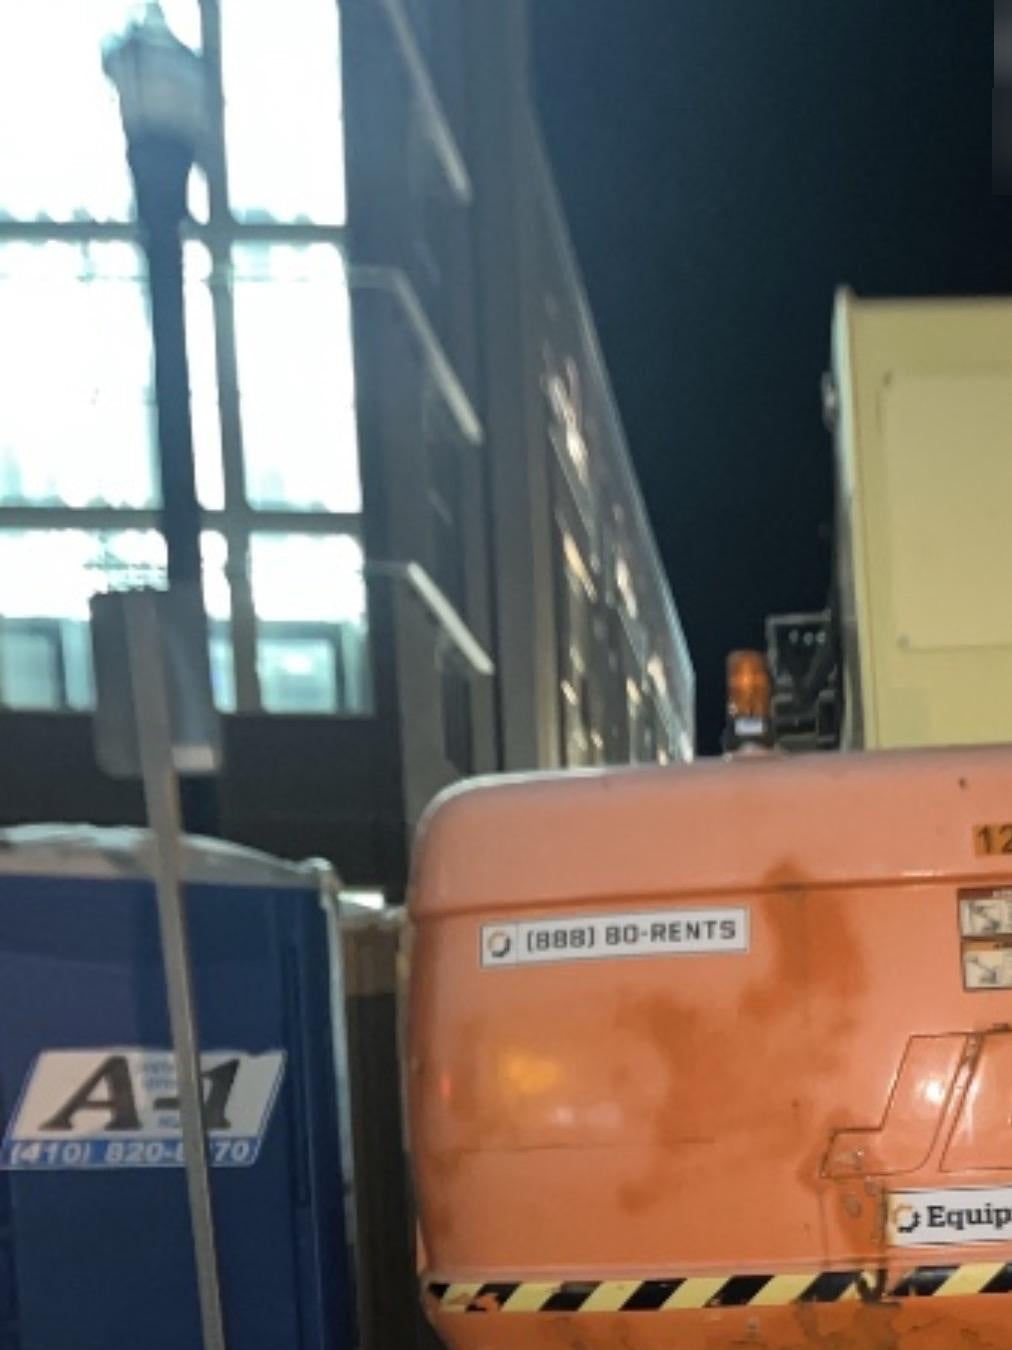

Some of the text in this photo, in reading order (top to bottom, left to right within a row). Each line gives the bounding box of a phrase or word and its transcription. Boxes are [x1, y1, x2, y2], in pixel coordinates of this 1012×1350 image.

[527, 919, 736, 953] (888) 80-RENTS
[37, 1054, 241, 1132] A-1
[10, 1140, 250, 1166] (410) 820-70
